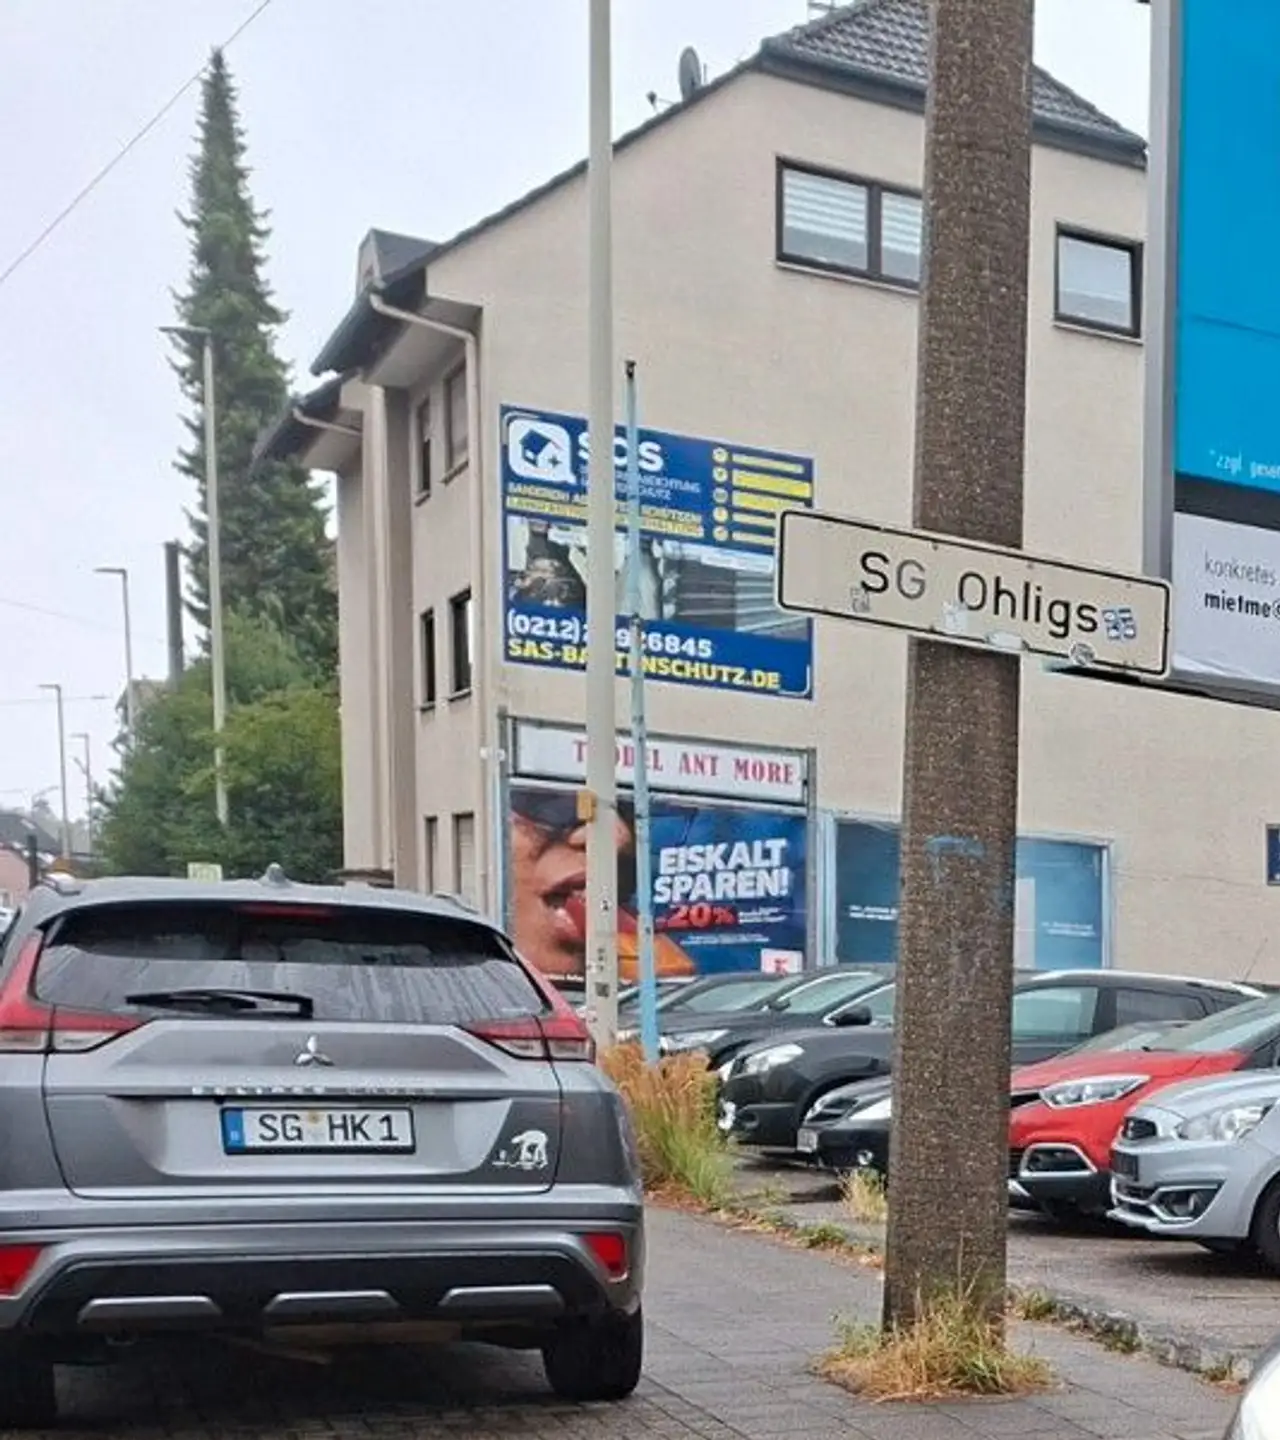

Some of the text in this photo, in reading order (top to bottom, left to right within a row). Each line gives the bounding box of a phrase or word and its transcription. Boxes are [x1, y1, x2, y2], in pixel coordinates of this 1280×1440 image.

[860, 551, 1099, 638] SG Ohligs
[679, 753, 719, 778] ANT
[733, 759, 794, 785] MORE
[659, 839, 788, 876] EISKALT
[653, 868, 791, 904] SPAREN!
[258, 1113, 399, 1142] SG HK 1
